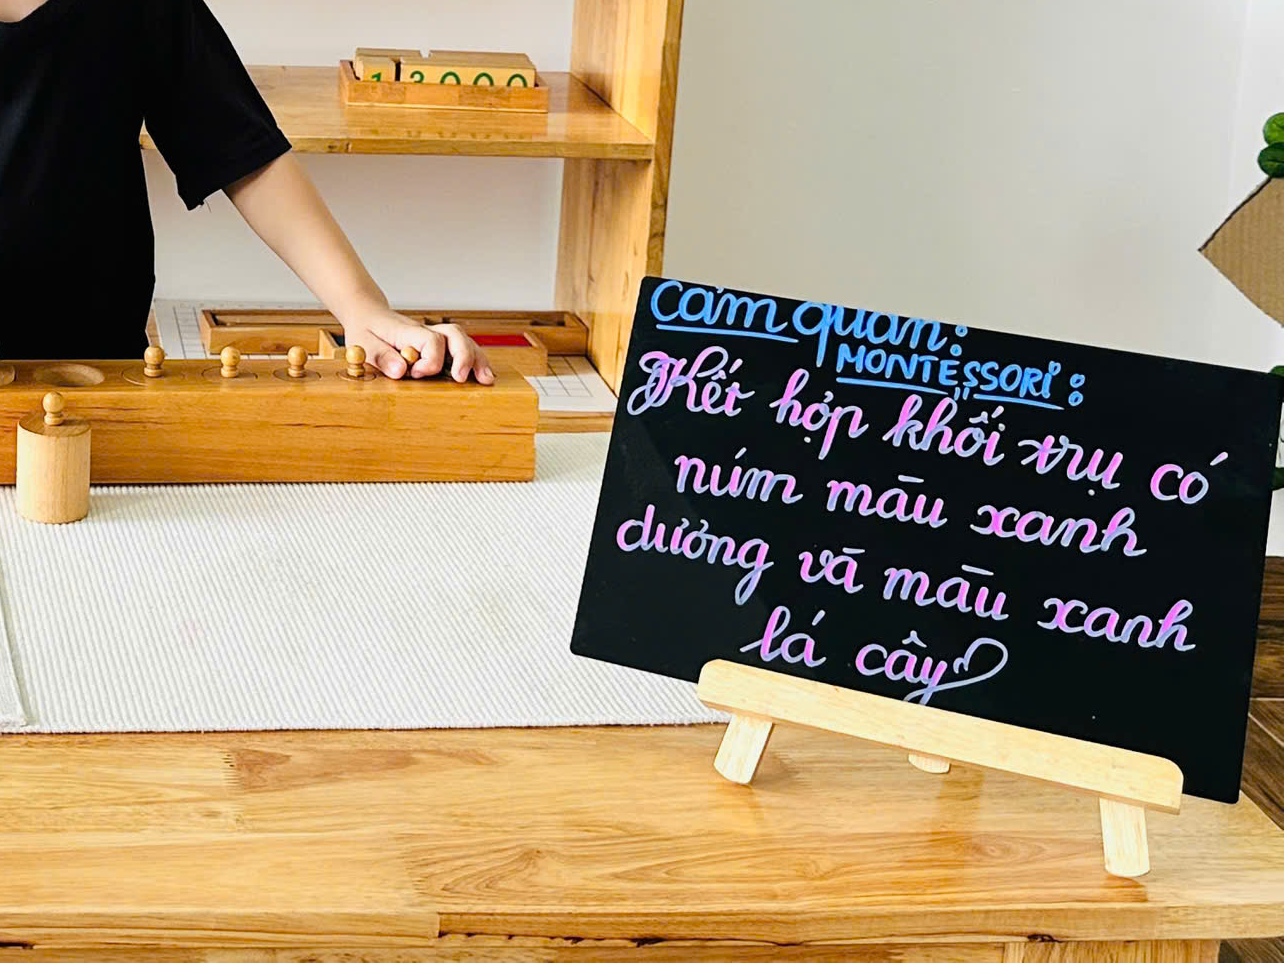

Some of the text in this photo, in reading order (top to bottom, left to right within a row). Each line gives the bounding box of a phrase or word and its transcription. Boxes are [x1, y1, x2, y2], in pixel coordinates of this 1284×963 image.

[627, 346, 1228, 504] Kết hợp khối trụ có
[674, 447, 803, 504] núm
[970, 506, 1147, 556] xanh
[740, 606, 948, 704] lá cây
[1036, 597, 1196, 651] xanh
